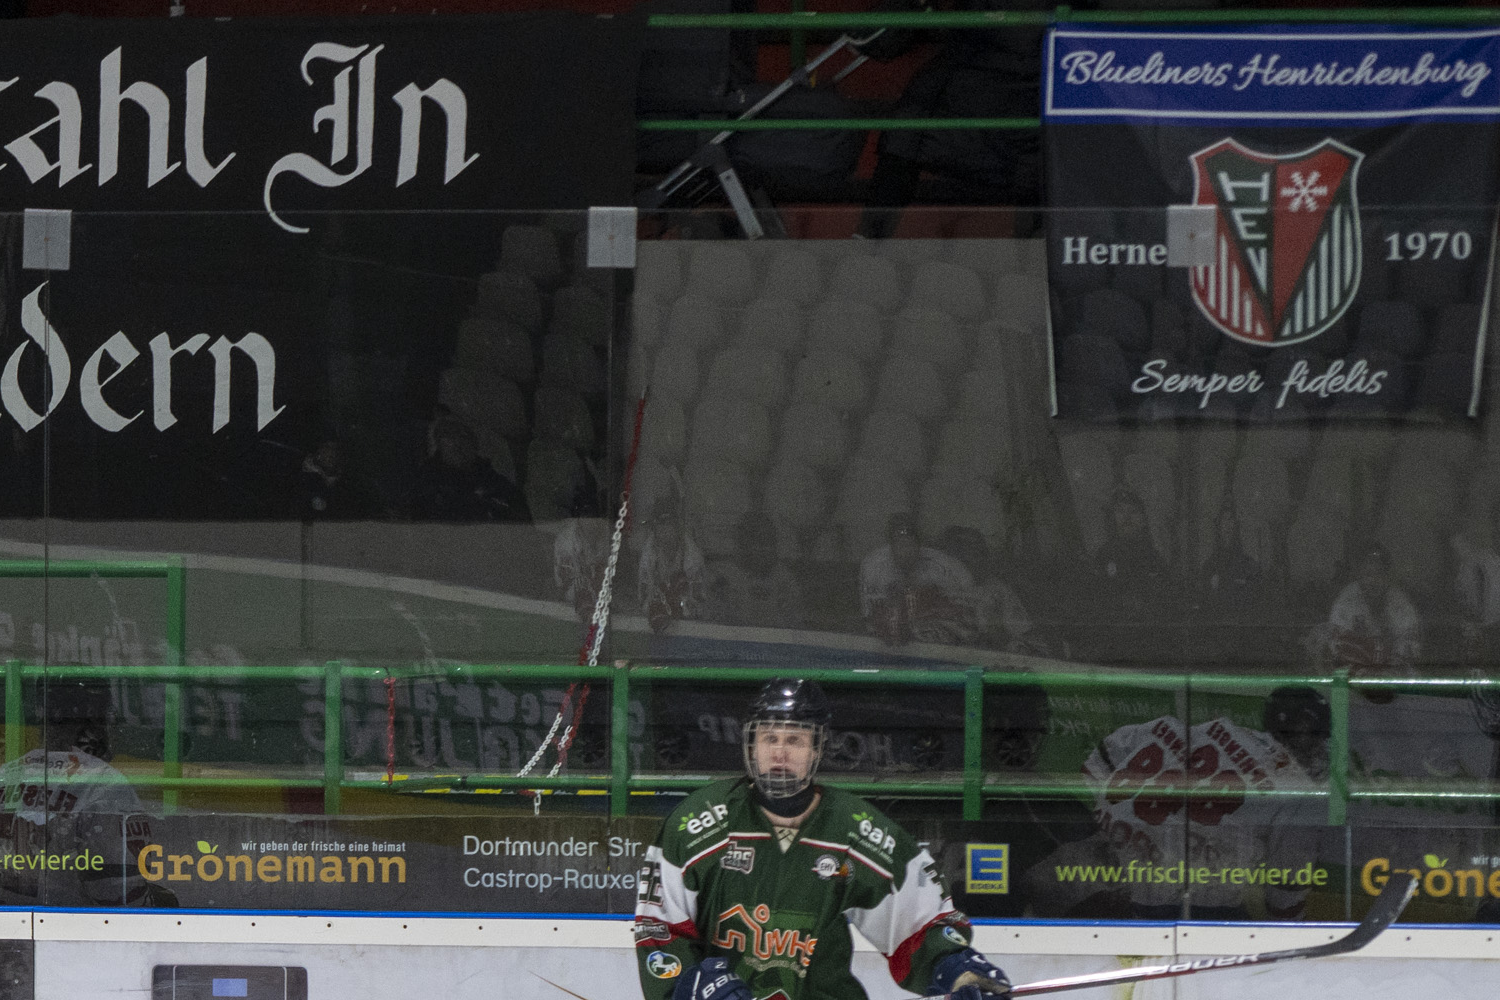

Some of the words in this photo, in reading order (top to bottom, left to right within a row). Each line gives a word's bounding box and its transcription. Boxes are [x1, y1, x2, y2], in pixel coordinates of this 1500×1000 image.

[1061, 50, 1232, 87] Blueliners
[1233, 52, 1491, 98] Henrichenburg
[264, 41, 479, 233] In
[1062, 236, 1168, 265] Herne
[1385, 232, 1472, 261] 1970
[1131, 359, 1264, 409] Semper
[242, 841, 257, 851] wir
[260, 841, 288, 853] geben
[292, 841, 308, 852] der
[311, 841, 346, 852] frische
[349, 842, 369, 852] eine
[372, 842, 406, 852] heimat
[463, 835, 598, 857] Dortmunder
[608, 837, 645, 857] Str.
[463, 867, 641, 893] Castrop-Rauxel
[1055, 859, 1329, 886] www.frische-revier.de
